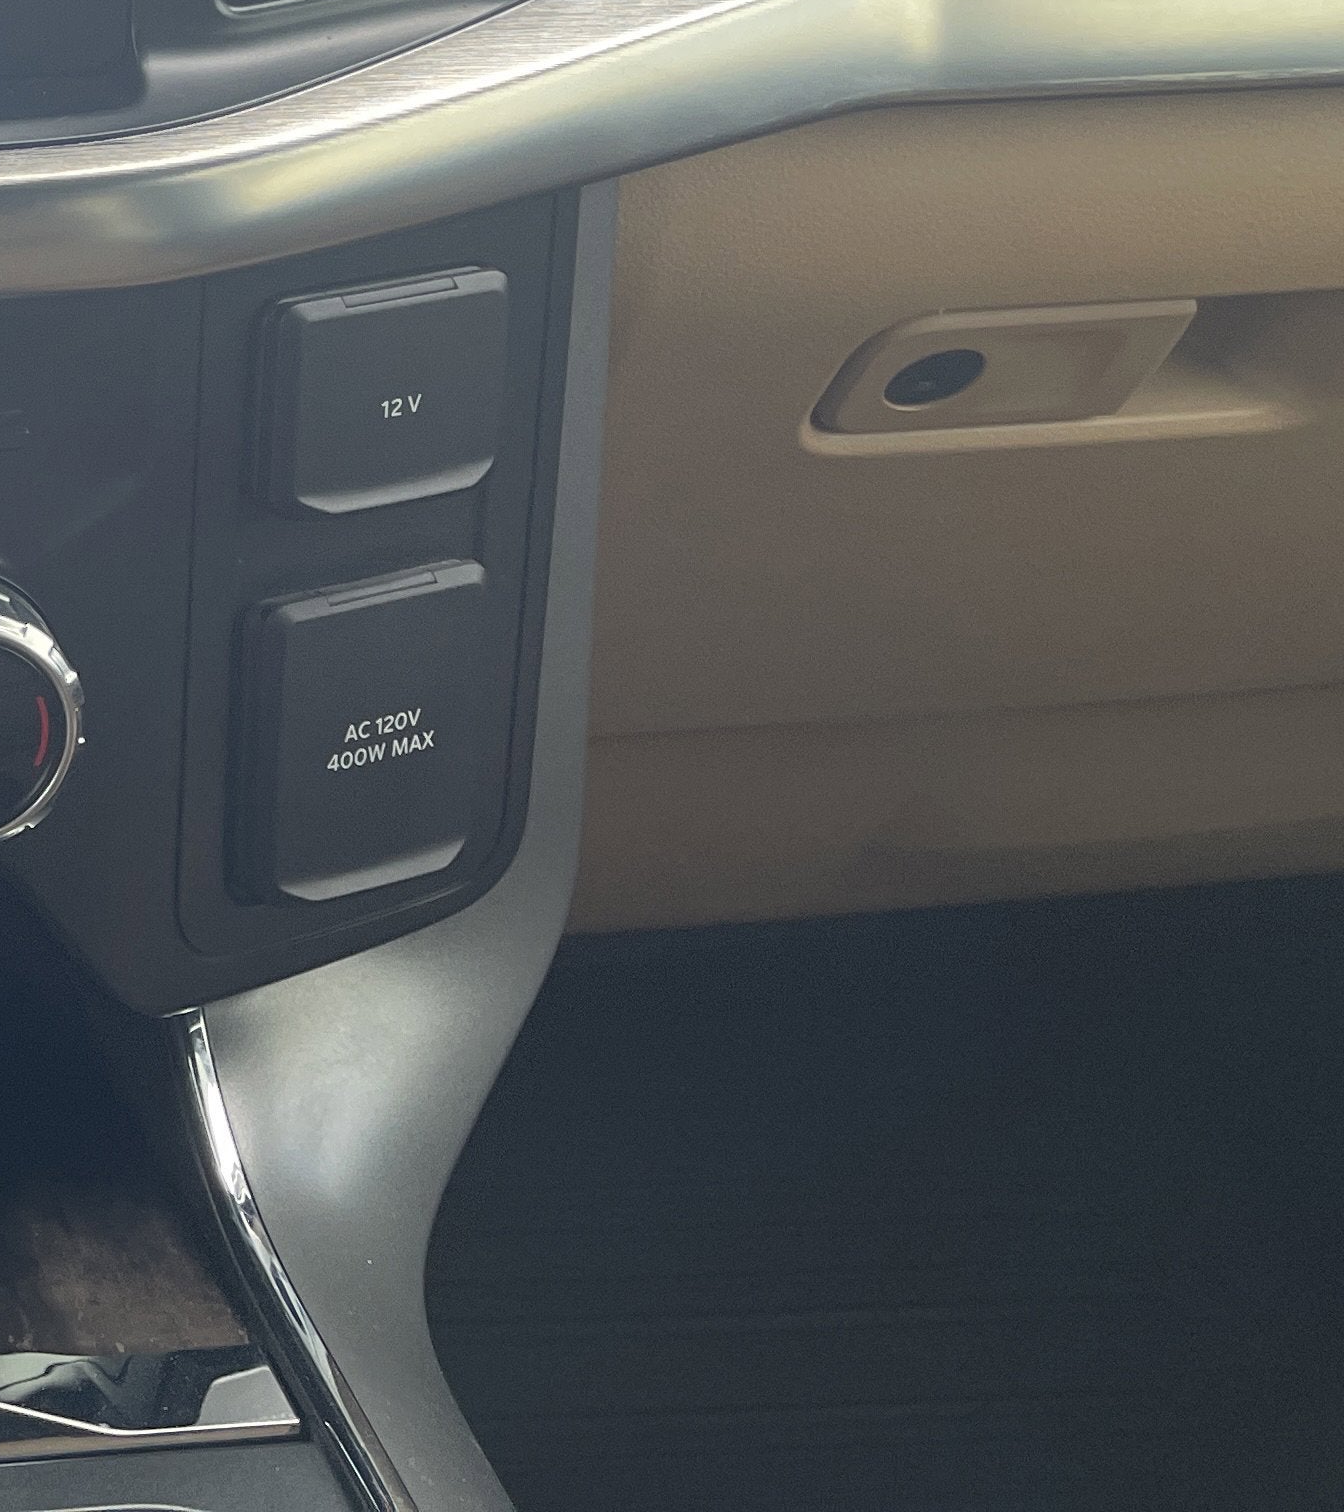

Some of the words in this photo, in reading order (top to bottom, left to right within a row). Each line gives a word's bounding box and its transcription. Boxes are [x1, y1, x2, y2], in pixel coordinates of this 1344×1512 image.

[380, 396, 403, 419] 12
[408, 393, 423, 415] V
[344, 719, 372, 743] AC
[375, 708, 422, 737] 120V
[327, 741, 387, 773] 400W
[391, 729, 435, 760] MAX
